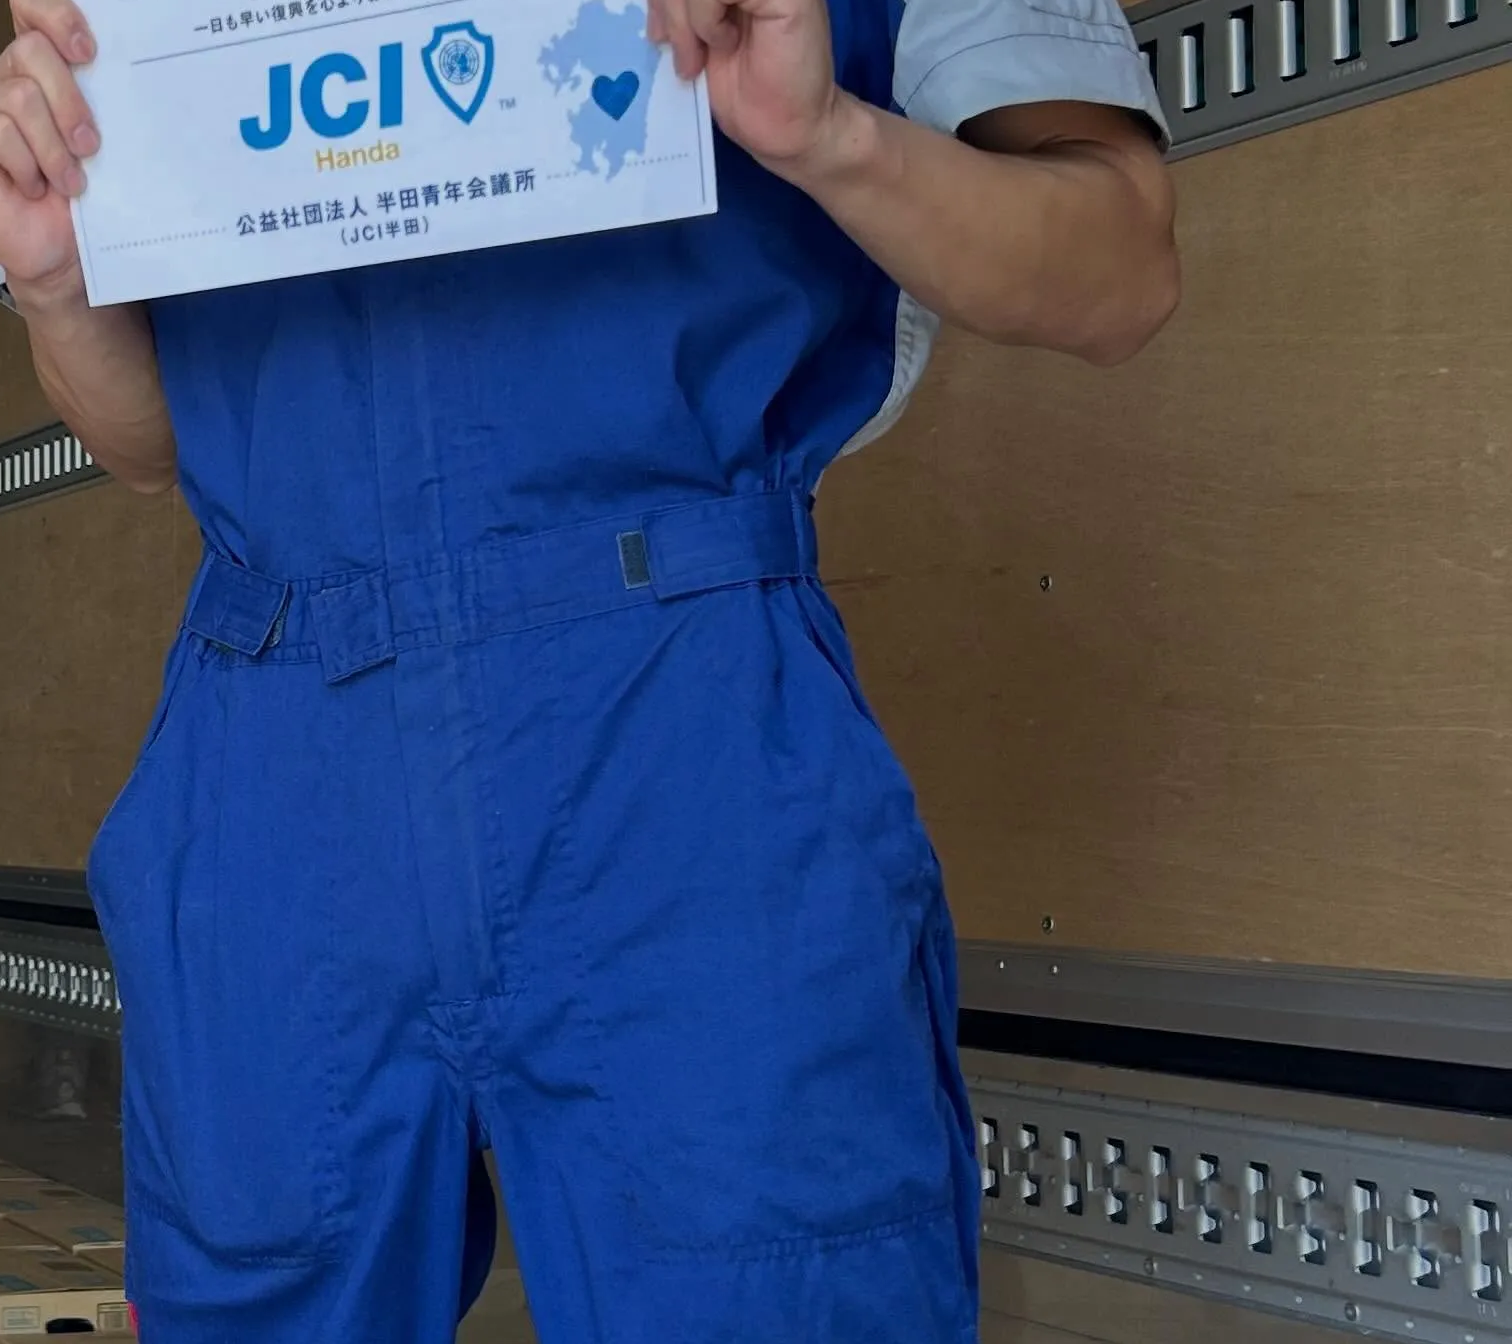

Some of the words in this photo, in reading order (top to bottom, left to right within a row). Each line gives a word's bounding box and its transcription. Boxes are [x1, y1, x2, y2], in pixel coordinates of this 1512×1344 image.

[240, 42, 403, 151] JCI
[316, 139, 401, 173] Handa
[237, 196, 368, 236] 公益社団法人
[376, 168, 536, 214] 半田青年会議所
